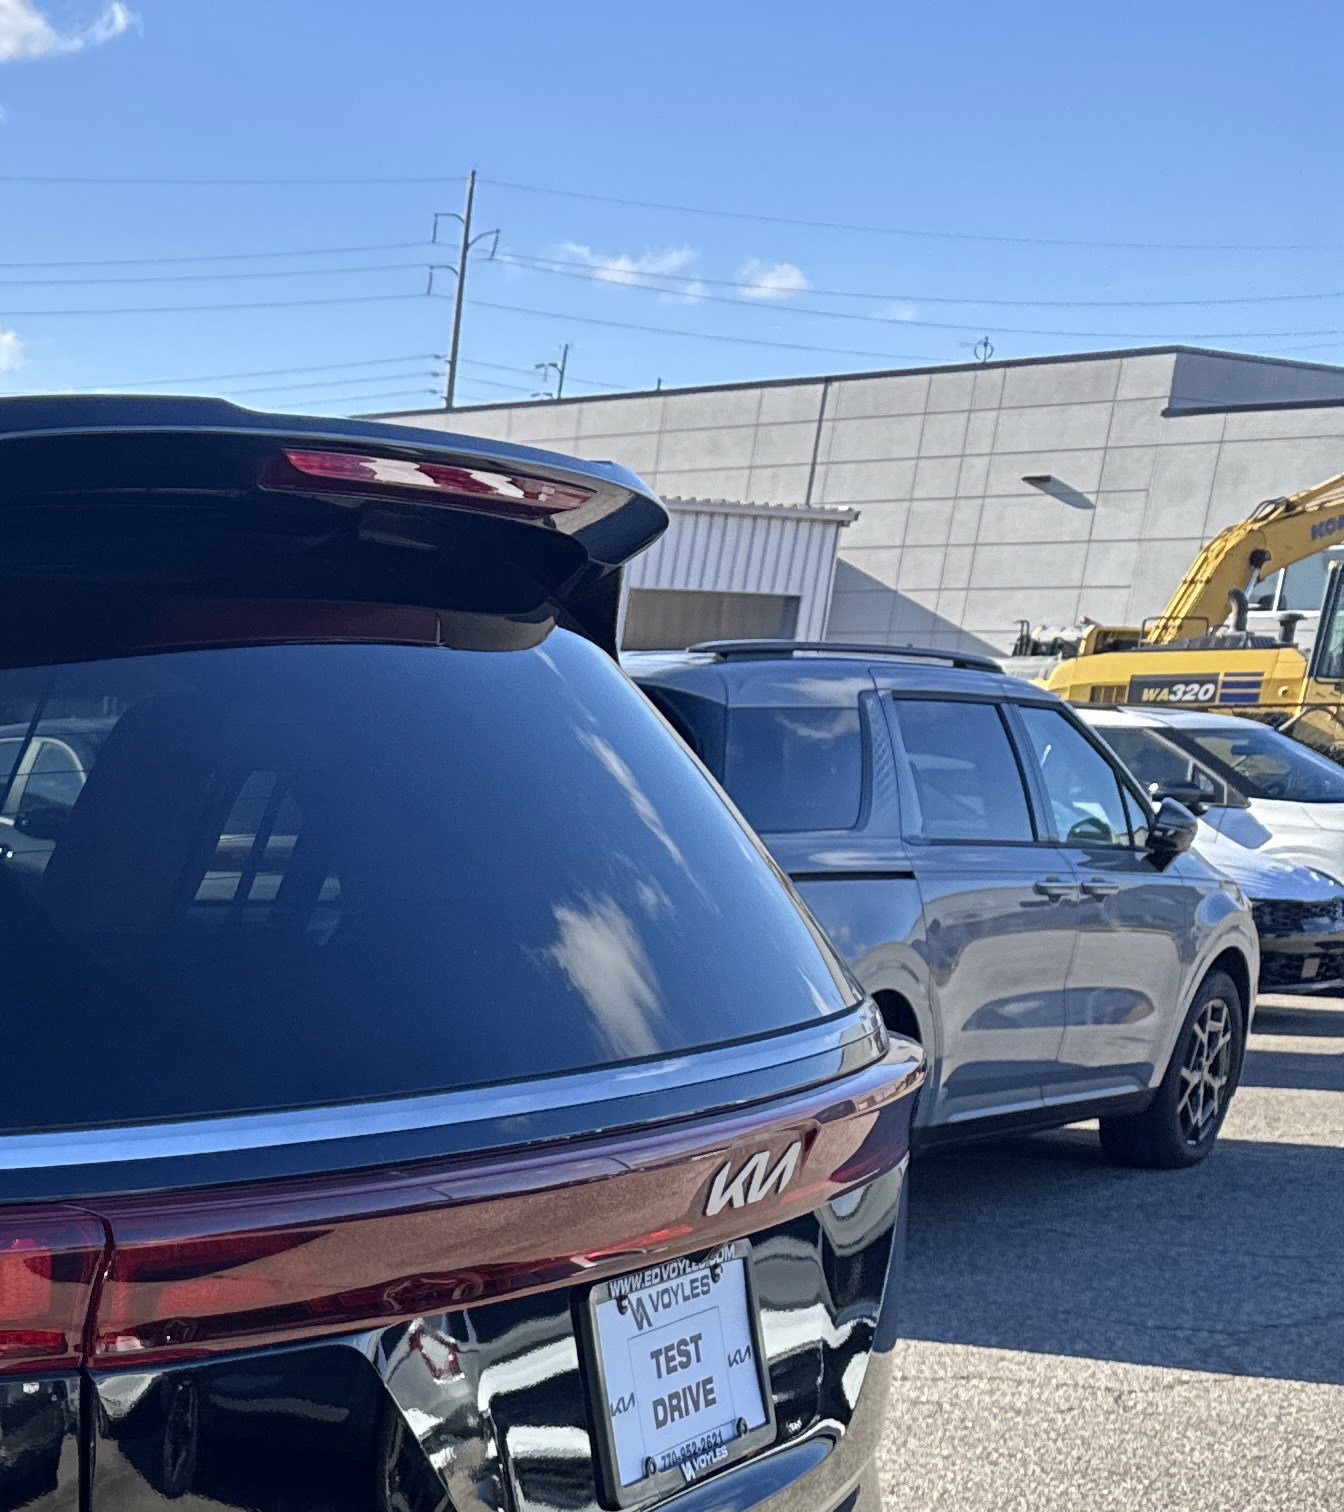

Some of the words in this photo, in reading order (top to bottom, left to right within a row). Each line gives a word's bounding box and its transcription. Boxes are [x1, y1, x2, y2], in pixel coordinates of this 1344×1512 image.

[1141, 683, 1216, 702] WA320
[705, 1141, 802, 1217] KIA
[648, 1274, 711, 1313] VOYLES
[650, 1332, 703, 1379] TEST
[652, 1376, 717, 1430] DRIVE
